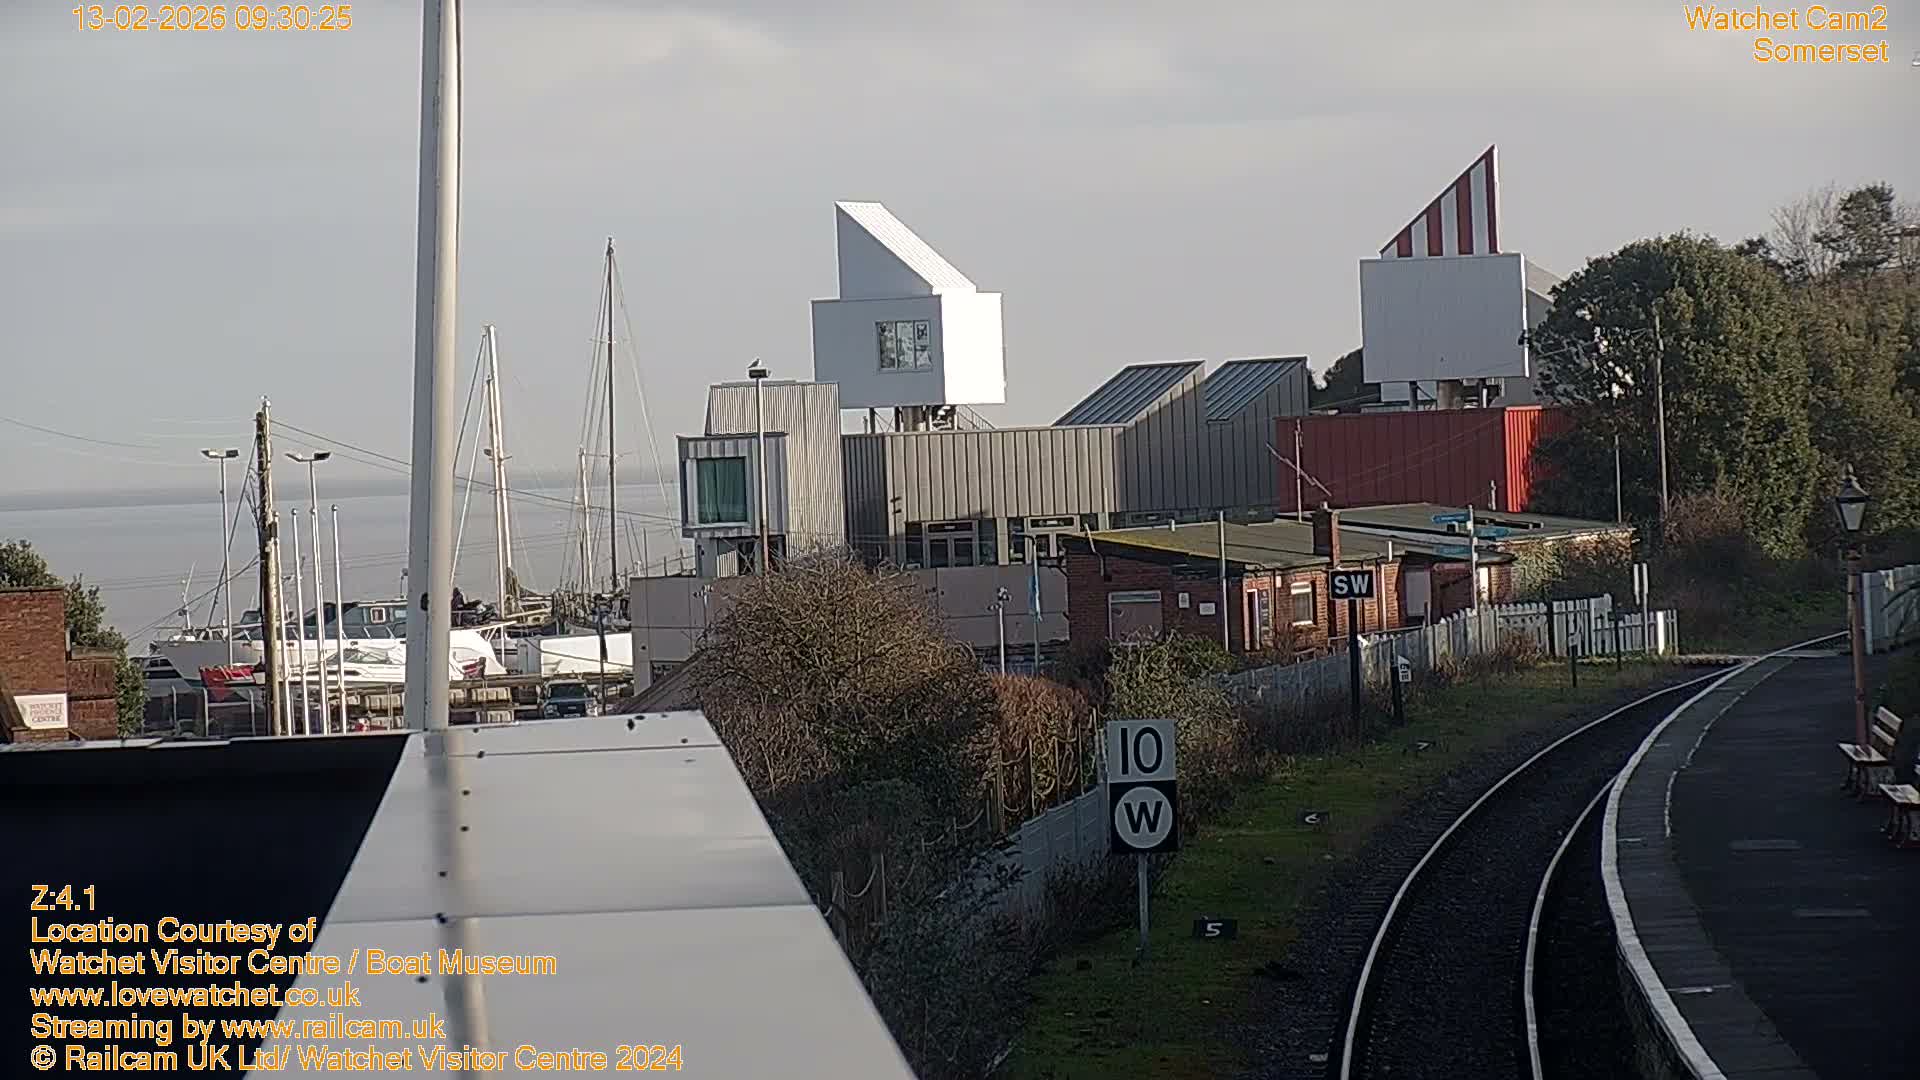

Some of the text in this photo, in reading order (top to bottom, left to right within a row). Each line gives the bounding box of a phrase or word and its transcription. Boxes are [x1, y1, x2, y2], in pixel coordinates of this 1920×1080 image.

[1335, 575, 1369, 594] SW
[1121, 726, 1163, 775] 10
[1124, 801, 1163, 833] W
[1205, 922, 1223, 937] 5
